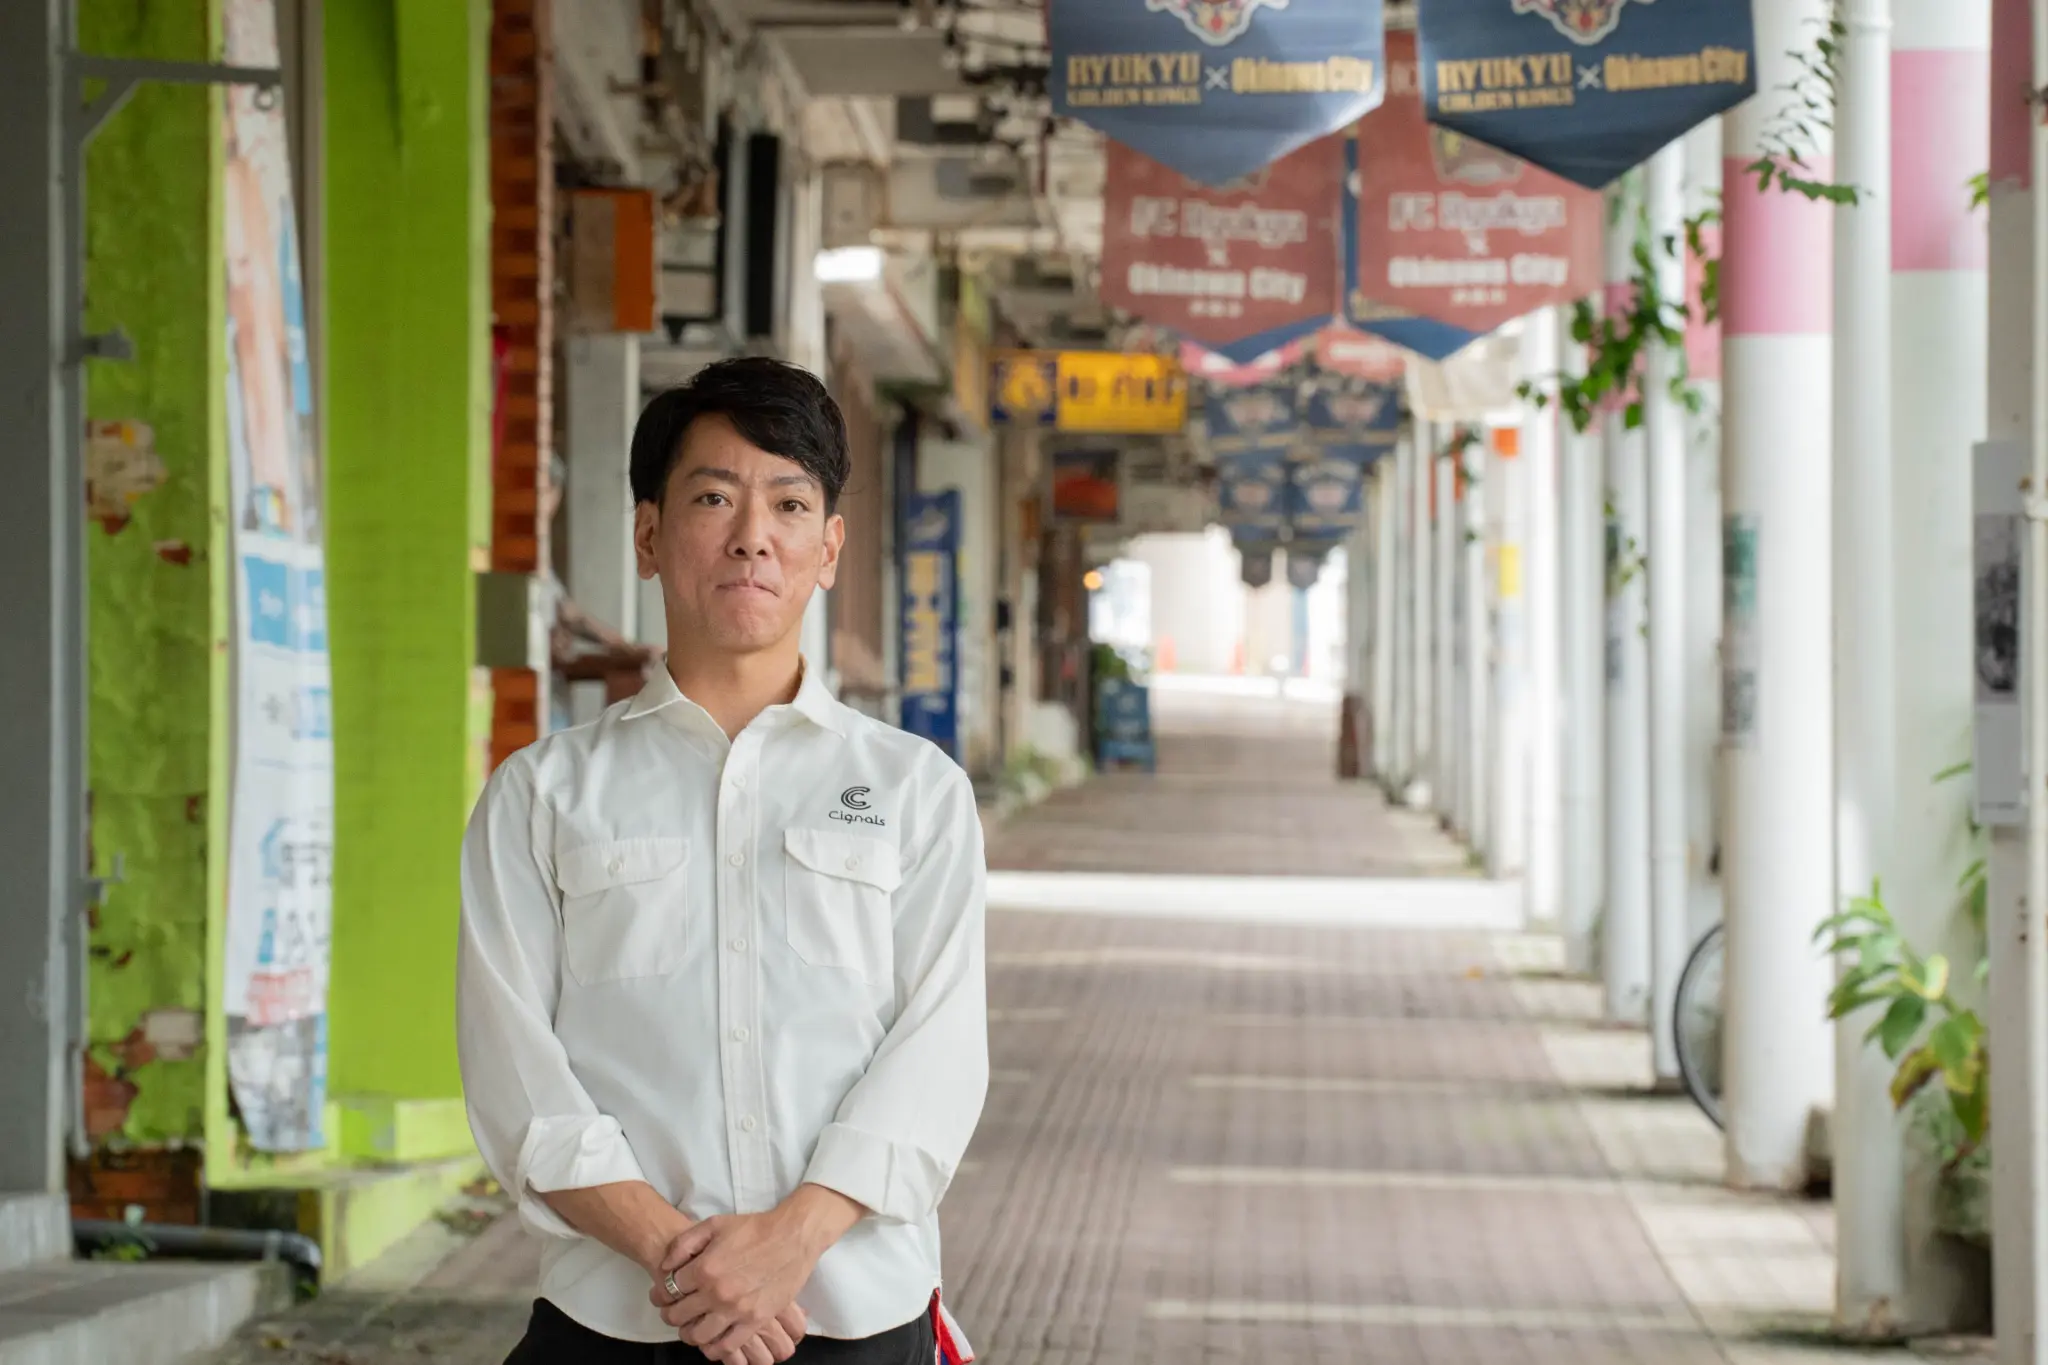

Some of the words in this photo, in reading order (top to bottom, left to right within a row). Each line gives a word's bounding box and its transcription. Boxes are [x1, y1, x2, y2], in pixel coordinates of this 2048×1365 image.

[1067, 52, 1199, 87] RYUKYU
[1437, 53, 1572, 91] RYUKYU
[828, 810, 886, 826] Cignals
